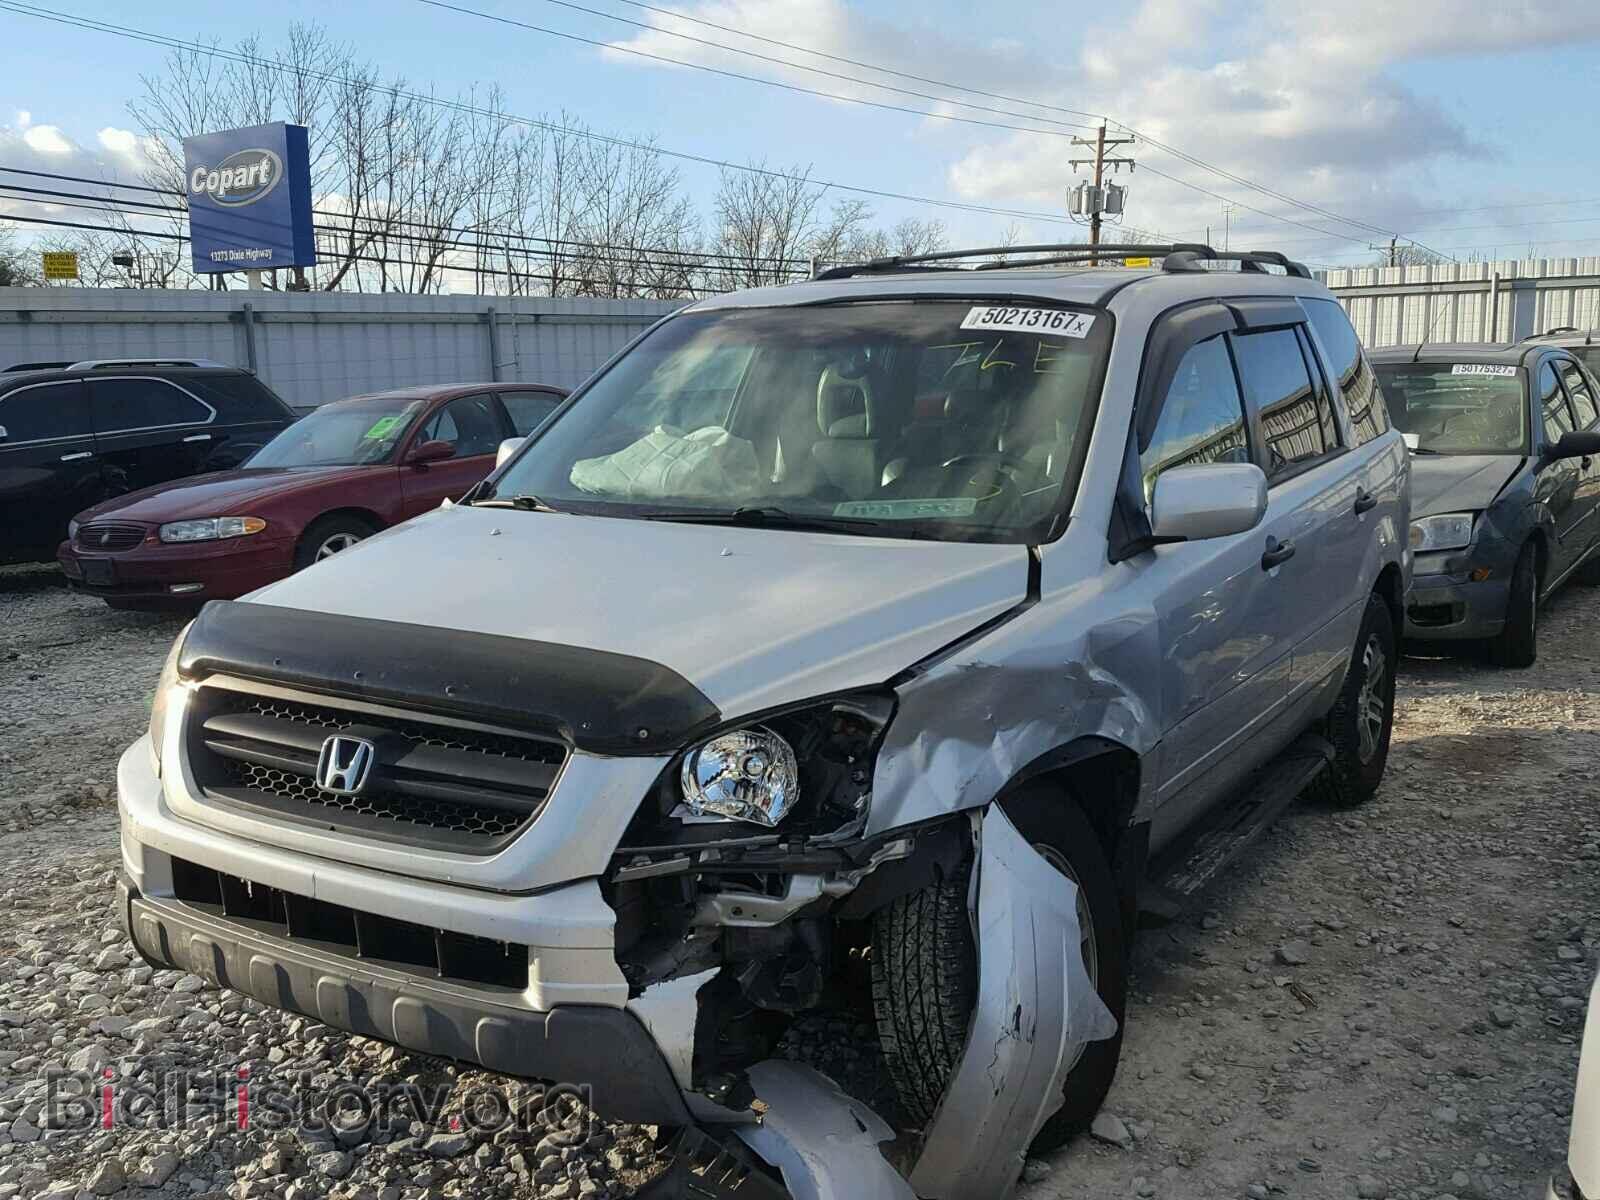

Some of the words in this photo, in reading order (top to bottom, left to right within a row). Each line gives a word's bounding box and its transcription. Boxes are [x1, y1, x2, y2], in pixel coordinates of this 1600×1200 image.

[191, 155, 272, 197] Copart
[210, 249, 228, 262] 13273
[229, 249, 244, 261] Dixie
[245, 247, 273, 261] Highway
